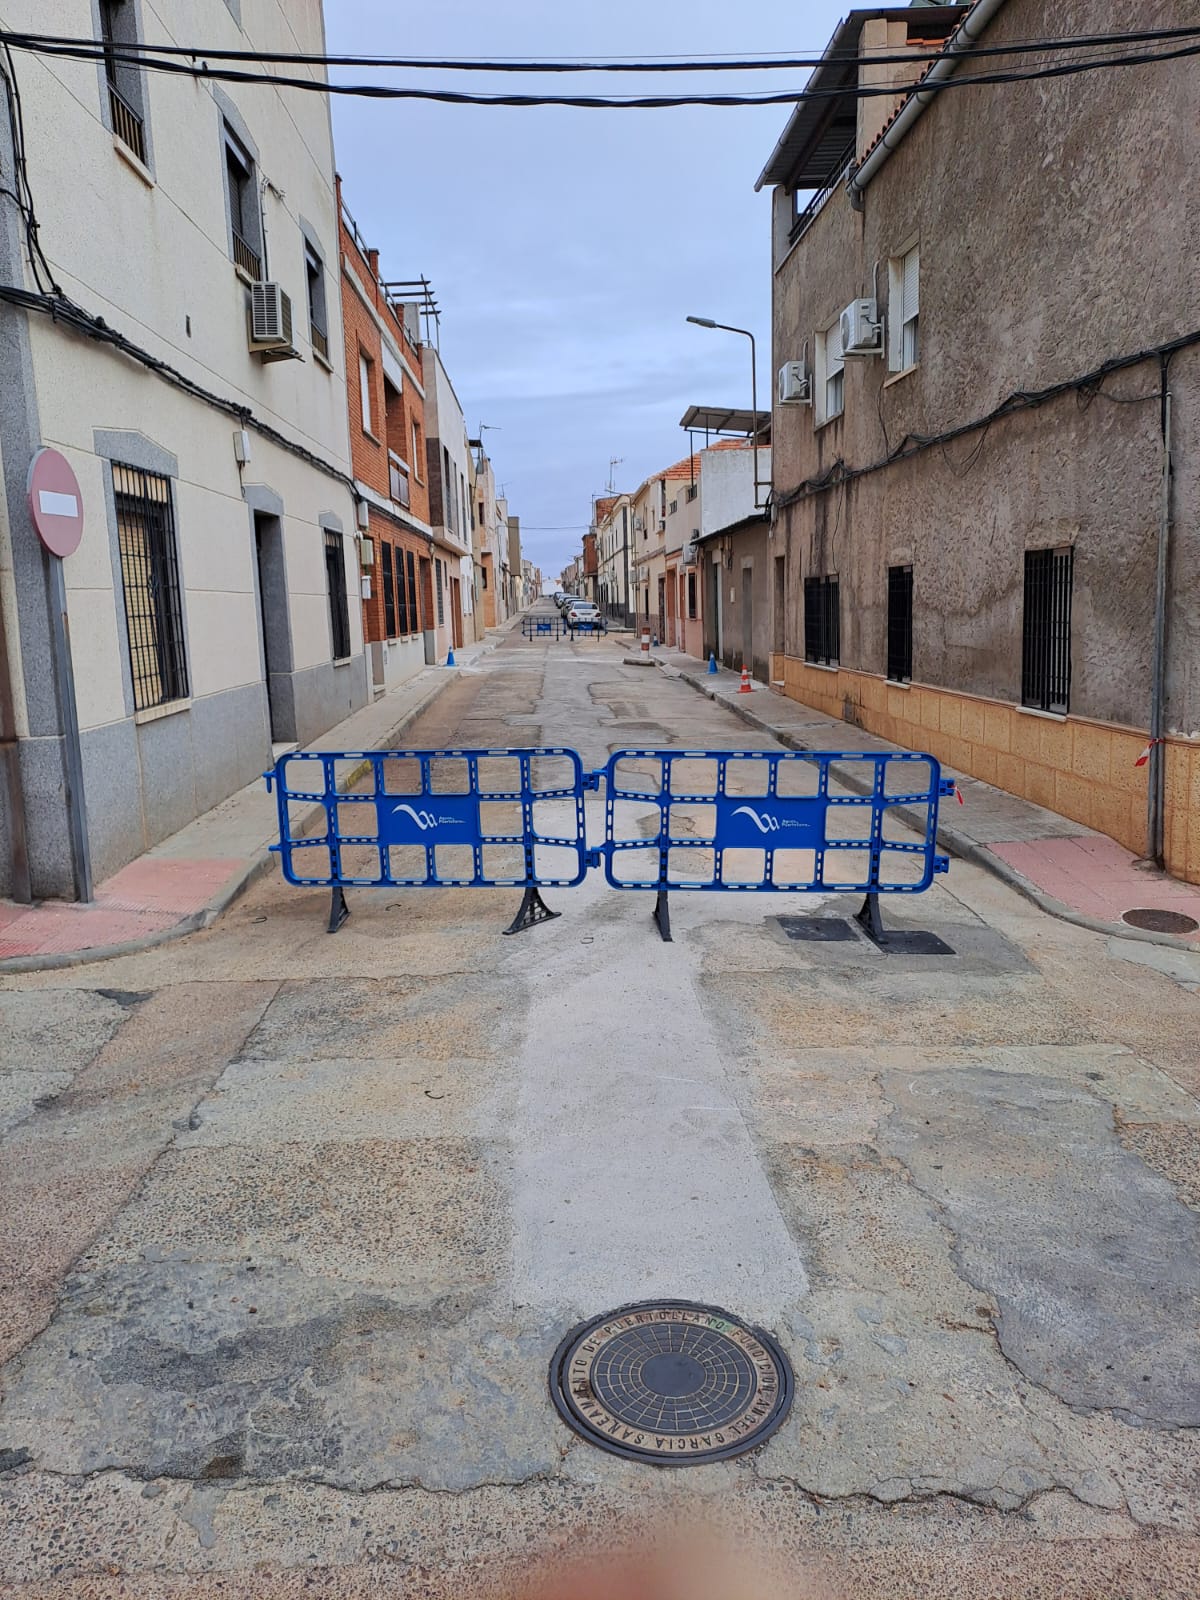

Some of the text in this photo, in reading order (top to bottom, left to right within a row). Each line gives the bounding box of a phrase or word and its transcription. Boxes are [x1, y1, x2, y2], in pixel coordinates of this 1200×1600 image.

[582, 1338, 602, 1353] DE
[603, 1311, 725, 1335] PUERTOLLANO
[655, 1329, 776, 1450] FUNDICION ANGEL GARCIA
